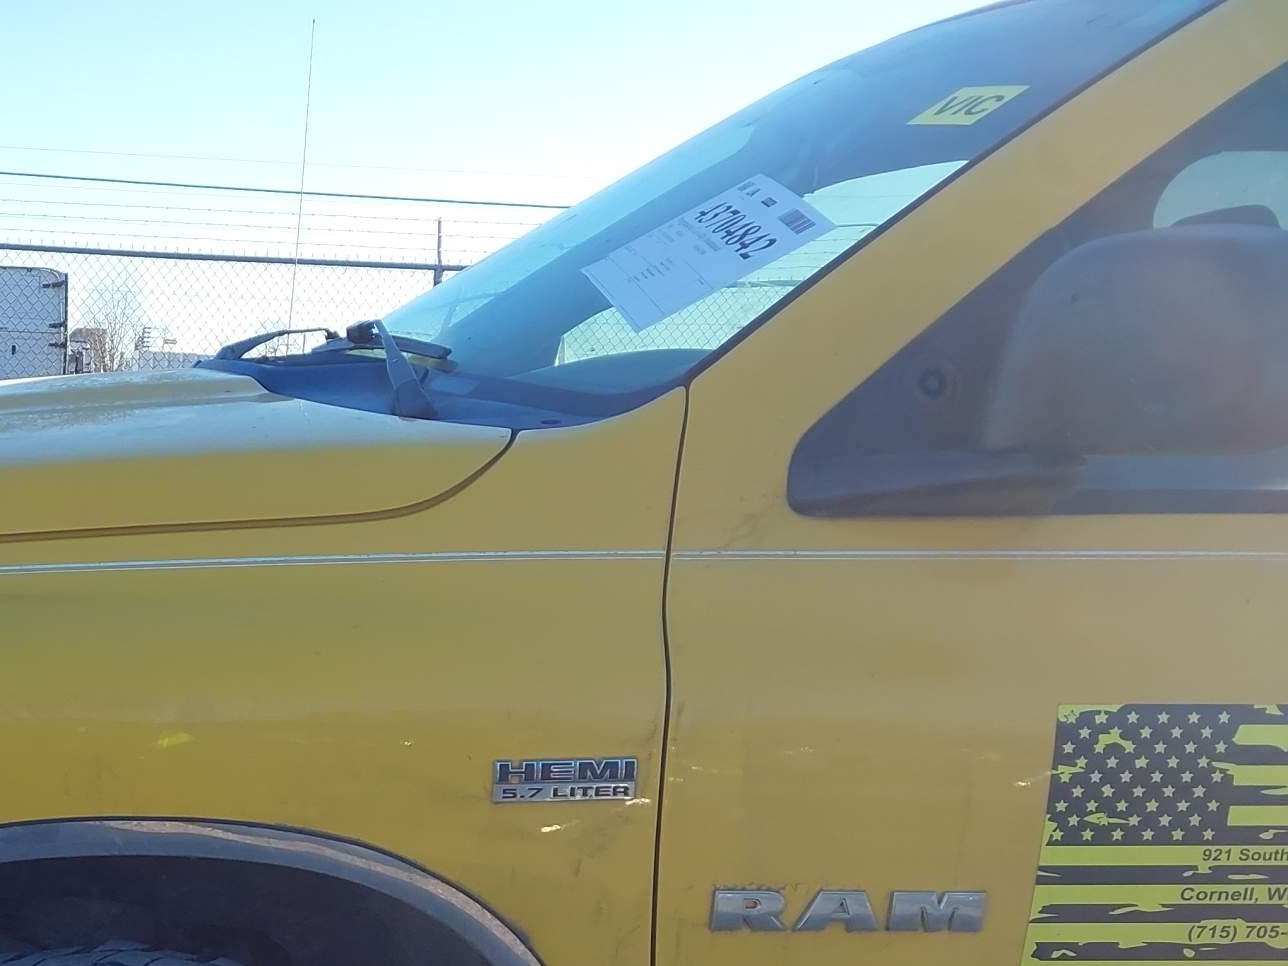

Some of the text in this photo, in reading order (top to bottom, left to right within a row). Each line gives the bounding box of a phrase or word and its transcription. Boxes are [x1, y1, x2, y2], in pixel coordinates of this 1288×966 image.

[933, 95, 1005, 116] VIC
[695, 201, 777, 260] 43704842
[496, 758, 638, 784] HEMI
[502, 785, 631, 799] 5.7 LITER
[1202, 848, 1232, 862] 921
[1180, 887, 1259, 904] Cornell,
[709, 888, 987, 933] RAM
[1188, 925, 1238, 942] (715)
